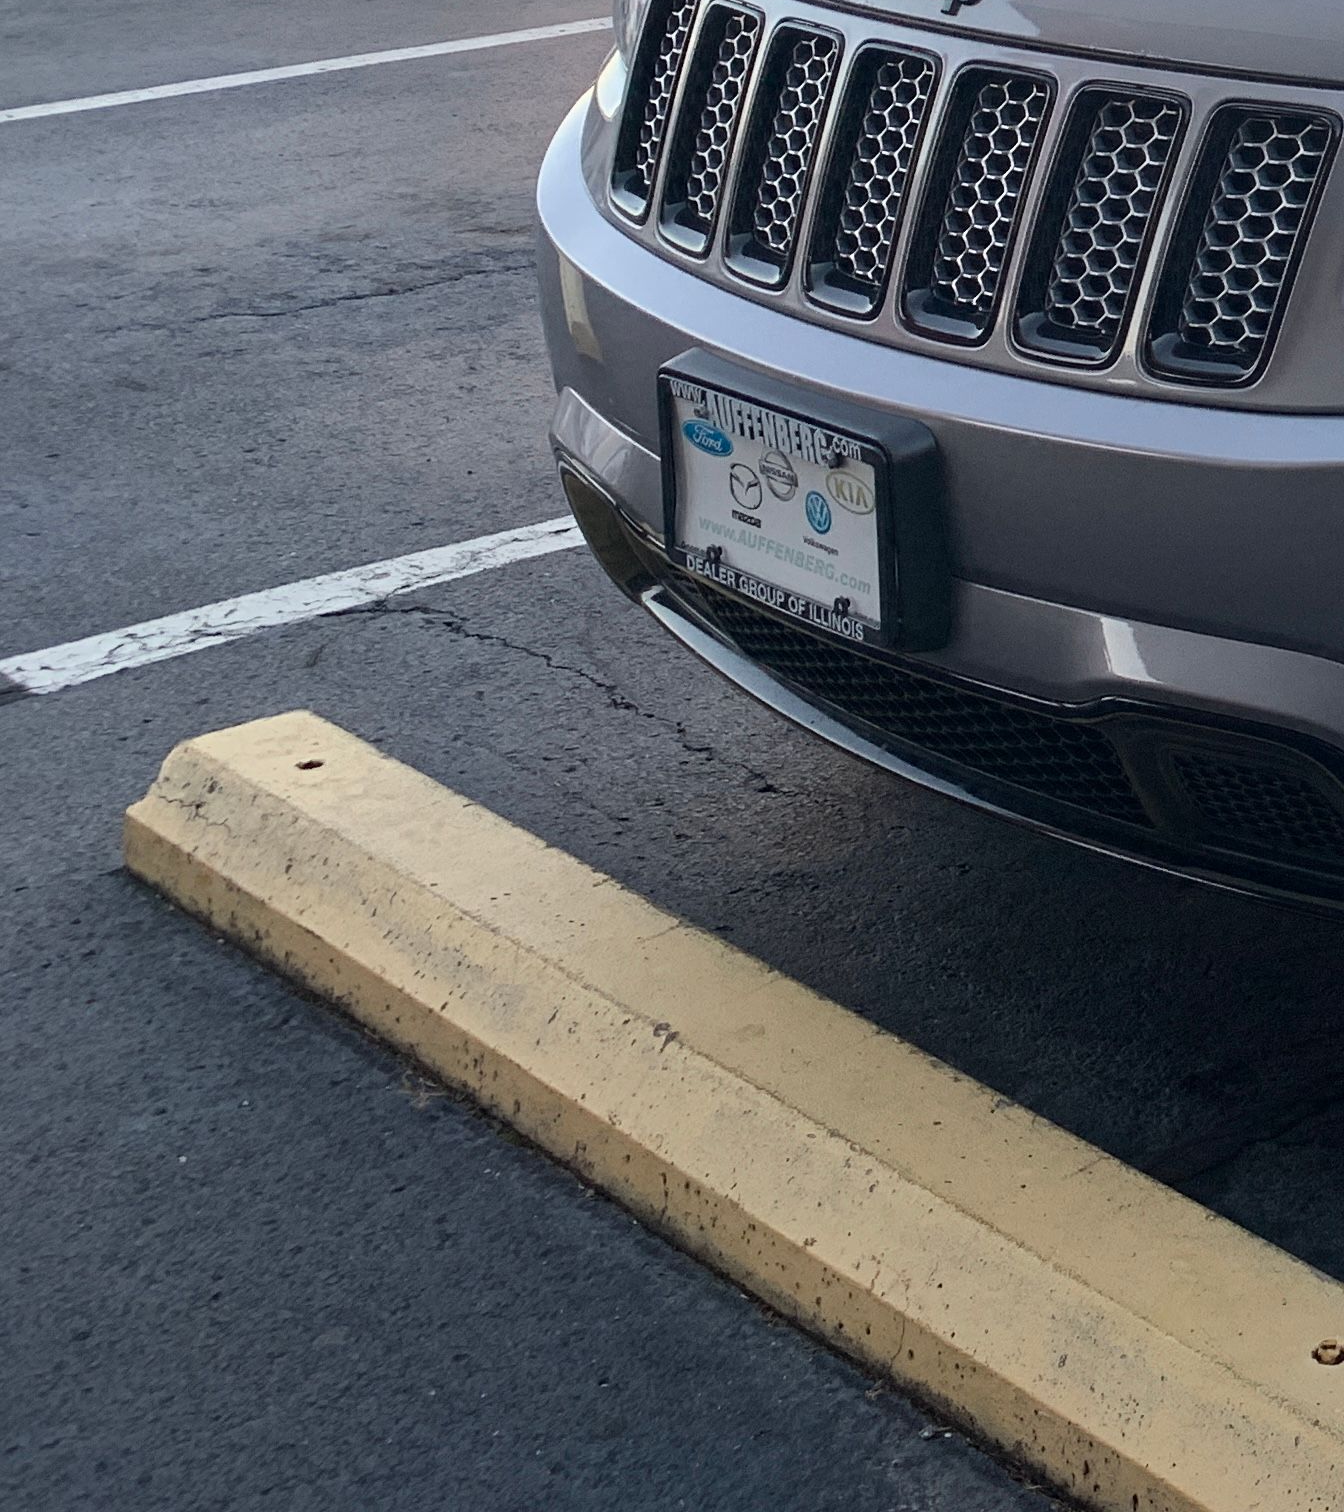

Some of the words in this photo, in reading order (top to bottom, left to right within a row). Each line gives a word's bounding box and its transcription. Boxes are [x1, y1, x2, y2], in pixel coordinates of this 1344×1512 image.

[693, 424, 723, 452] Ford
[834, 477, 869, 508] KIA
[732, 510, 761, 528] mazda
[699, 517, 871, 594] www.AUFFENBERG.com
[686, 554, 736, 589] DEALER
[739, 576, 785, 608] GROUP
[788, 596, 805, 615] OF
[809, 603, 864, 641] ILLINOIS
